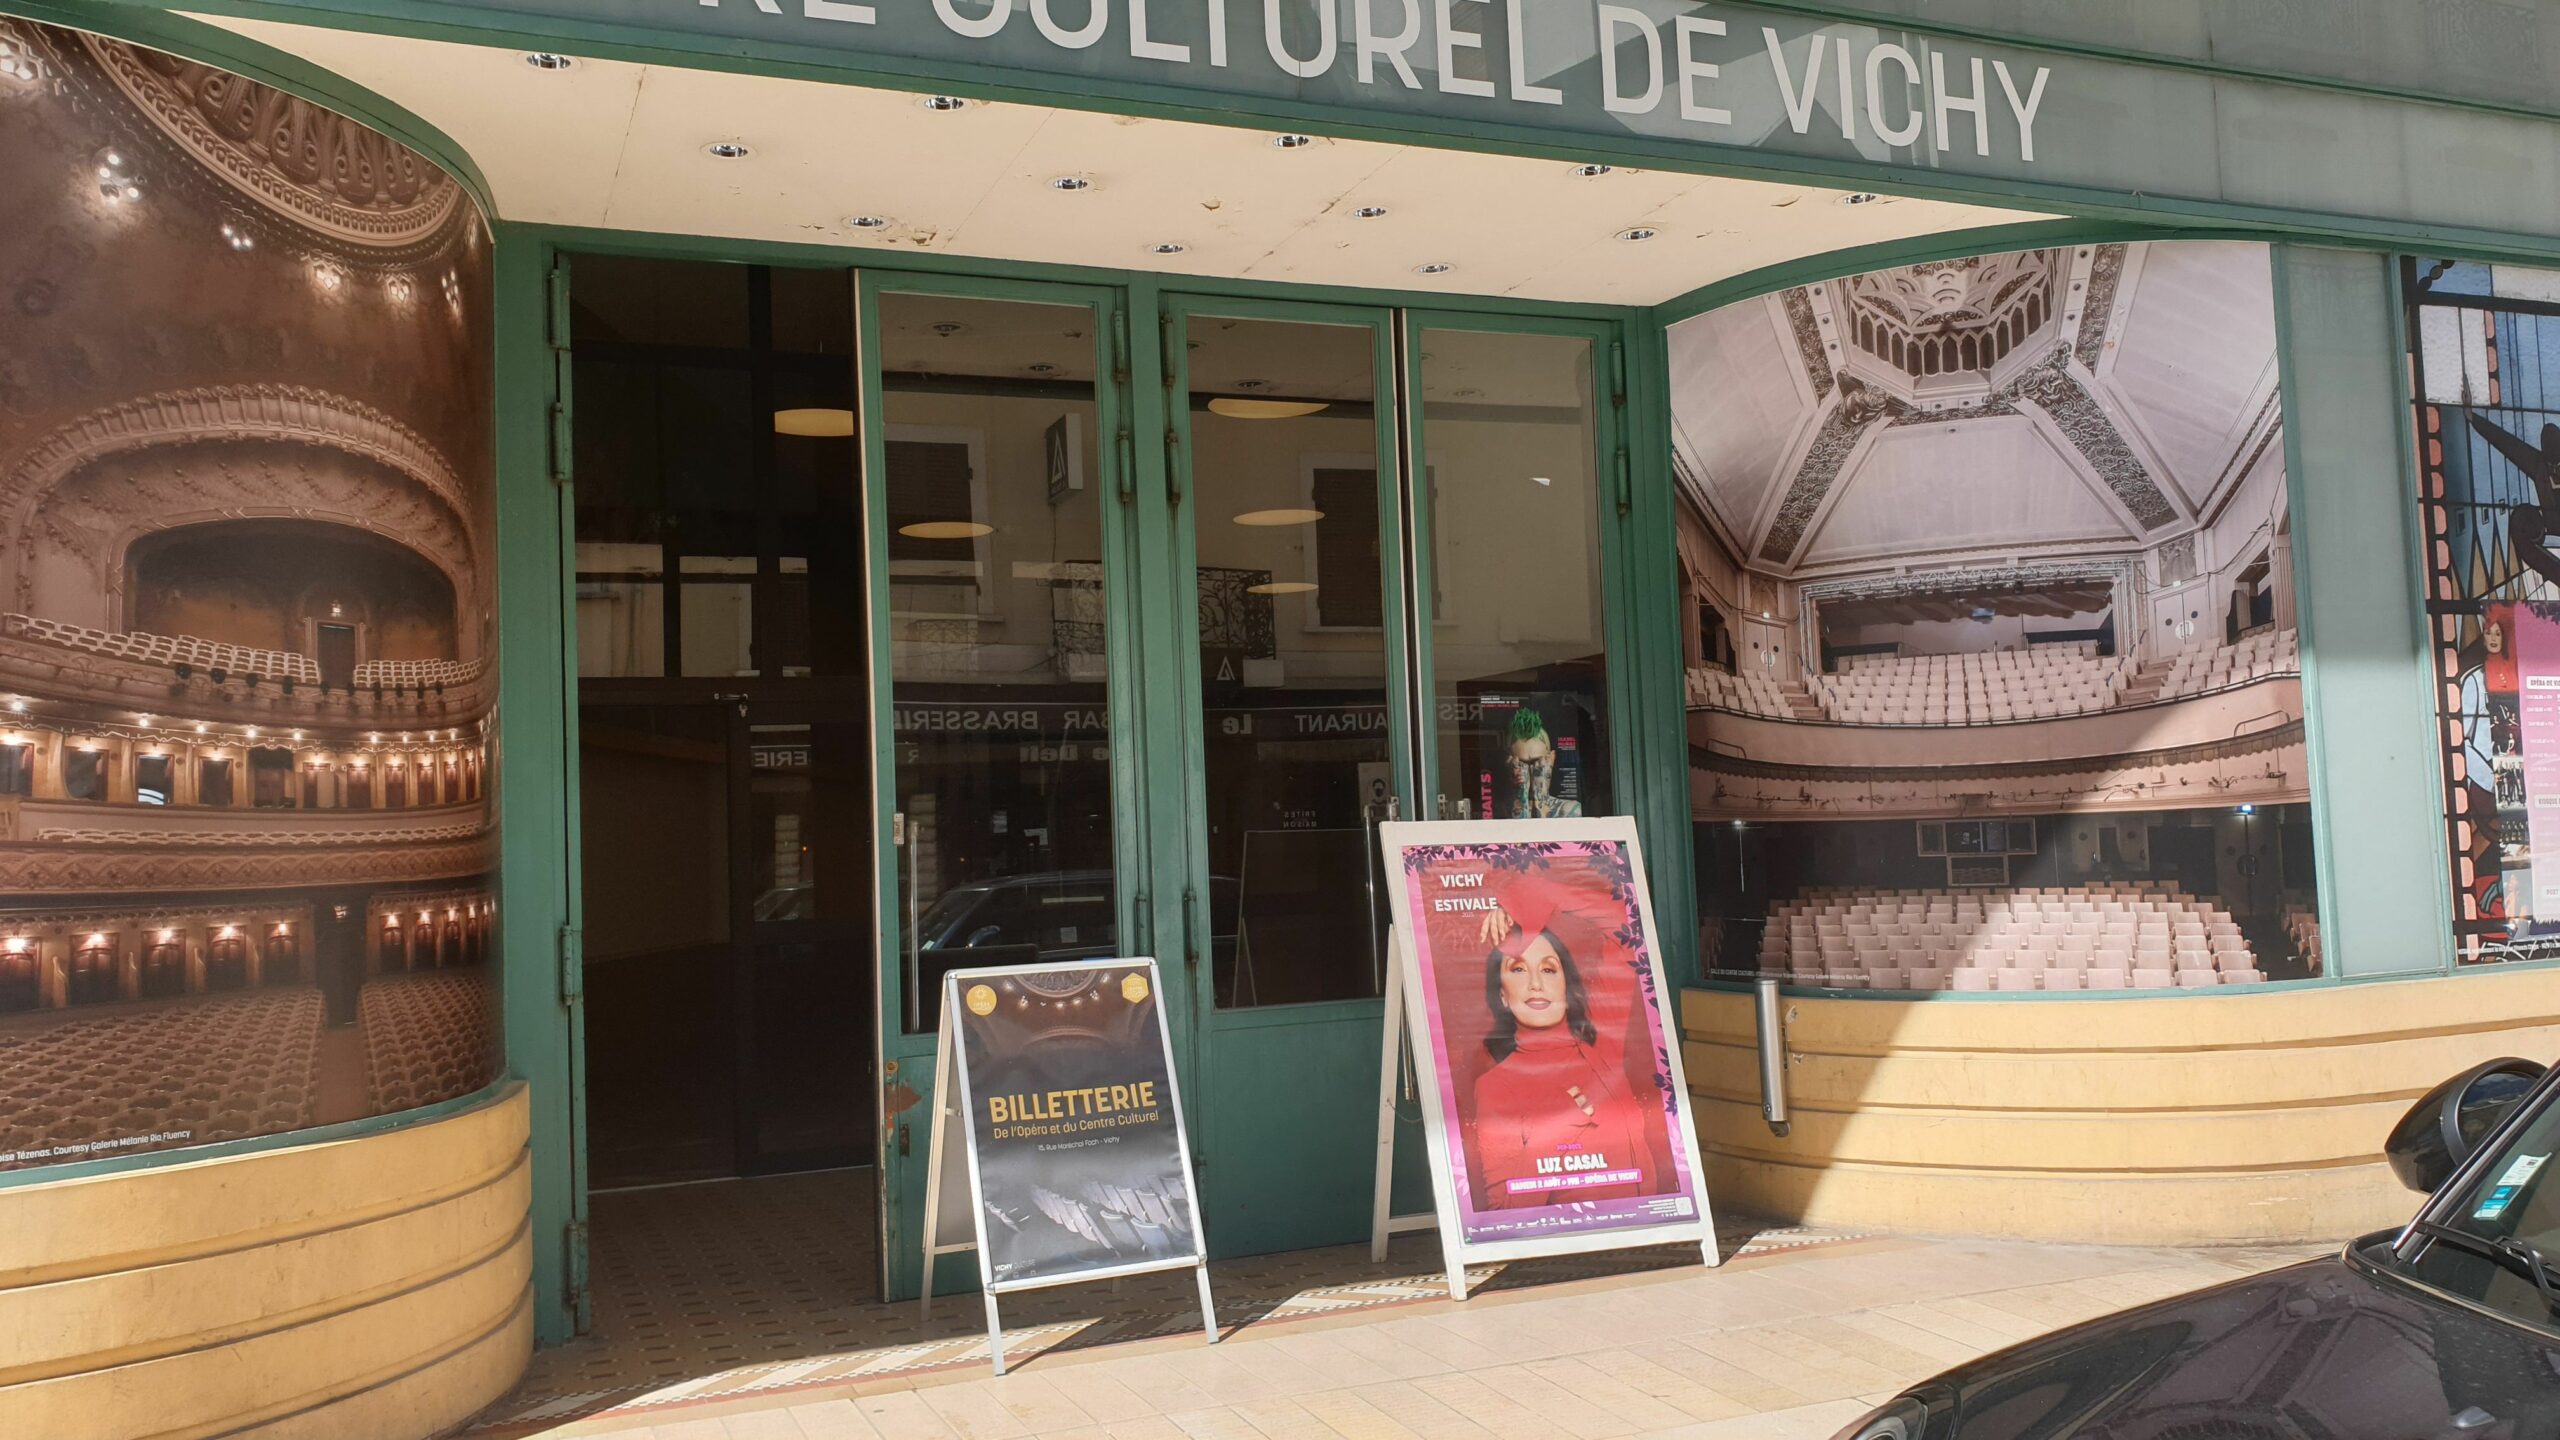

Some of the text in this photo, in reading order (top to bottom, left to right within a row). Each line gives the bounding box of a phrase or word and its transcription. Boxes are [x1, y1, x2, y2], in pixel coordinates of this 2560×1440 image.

[1598, 5, 1732, 125] DE
[1761, 26, 2050, 162] VICHY
[1439, 873, 1484, 888] VICHY
[1434, 897, 1498, 912] ESTIVALE
[989, 1081, 1157, 1123] BILLETTERIE
[994, 1110, 1159, 1139] De l'Opéra et du Centre Culturel
[53, 1143, 90, 1156] Courtesy
[91, 1139, 118, 1151] Galerie
[119, 1134, 149, 1147] Mélanie
[163, 1129, 191, 1140] Fluency
[1046, 1143, 1057, 1151] Rue
[1085, 1139, 1099, 1147] Foch
[1103, 1136, 1120, 1144] Vichy
[1536, 1153, 1608, 1174] LUZ CASAL
[994, 1263, 1012, 1272] VICHY
